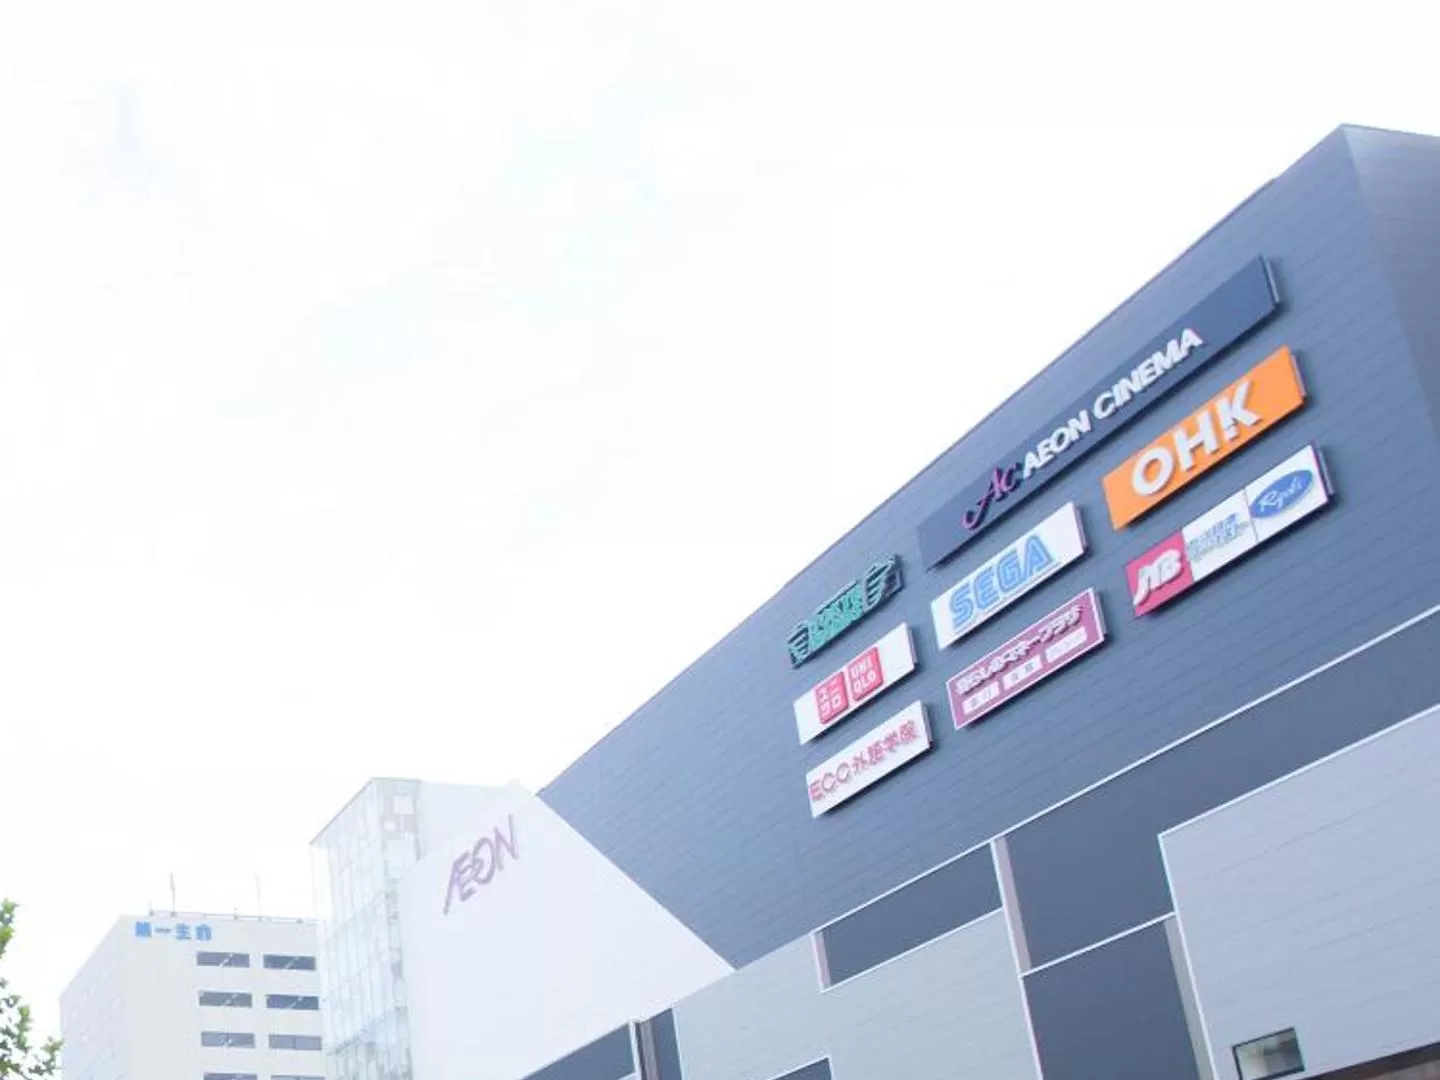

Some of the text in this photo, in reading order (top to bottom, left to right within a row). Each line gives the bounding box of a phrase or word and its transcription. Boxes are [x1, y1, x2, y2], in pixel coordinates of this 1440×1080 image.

[1023, 409, 1092, 479] AEON
[1093, 327, 1203, 419] CINEMA
[1132, 379, 1261, 497] OHK
[950, 534, 1056, 632] SEGA
[443, 813, 520, 916] AEON
